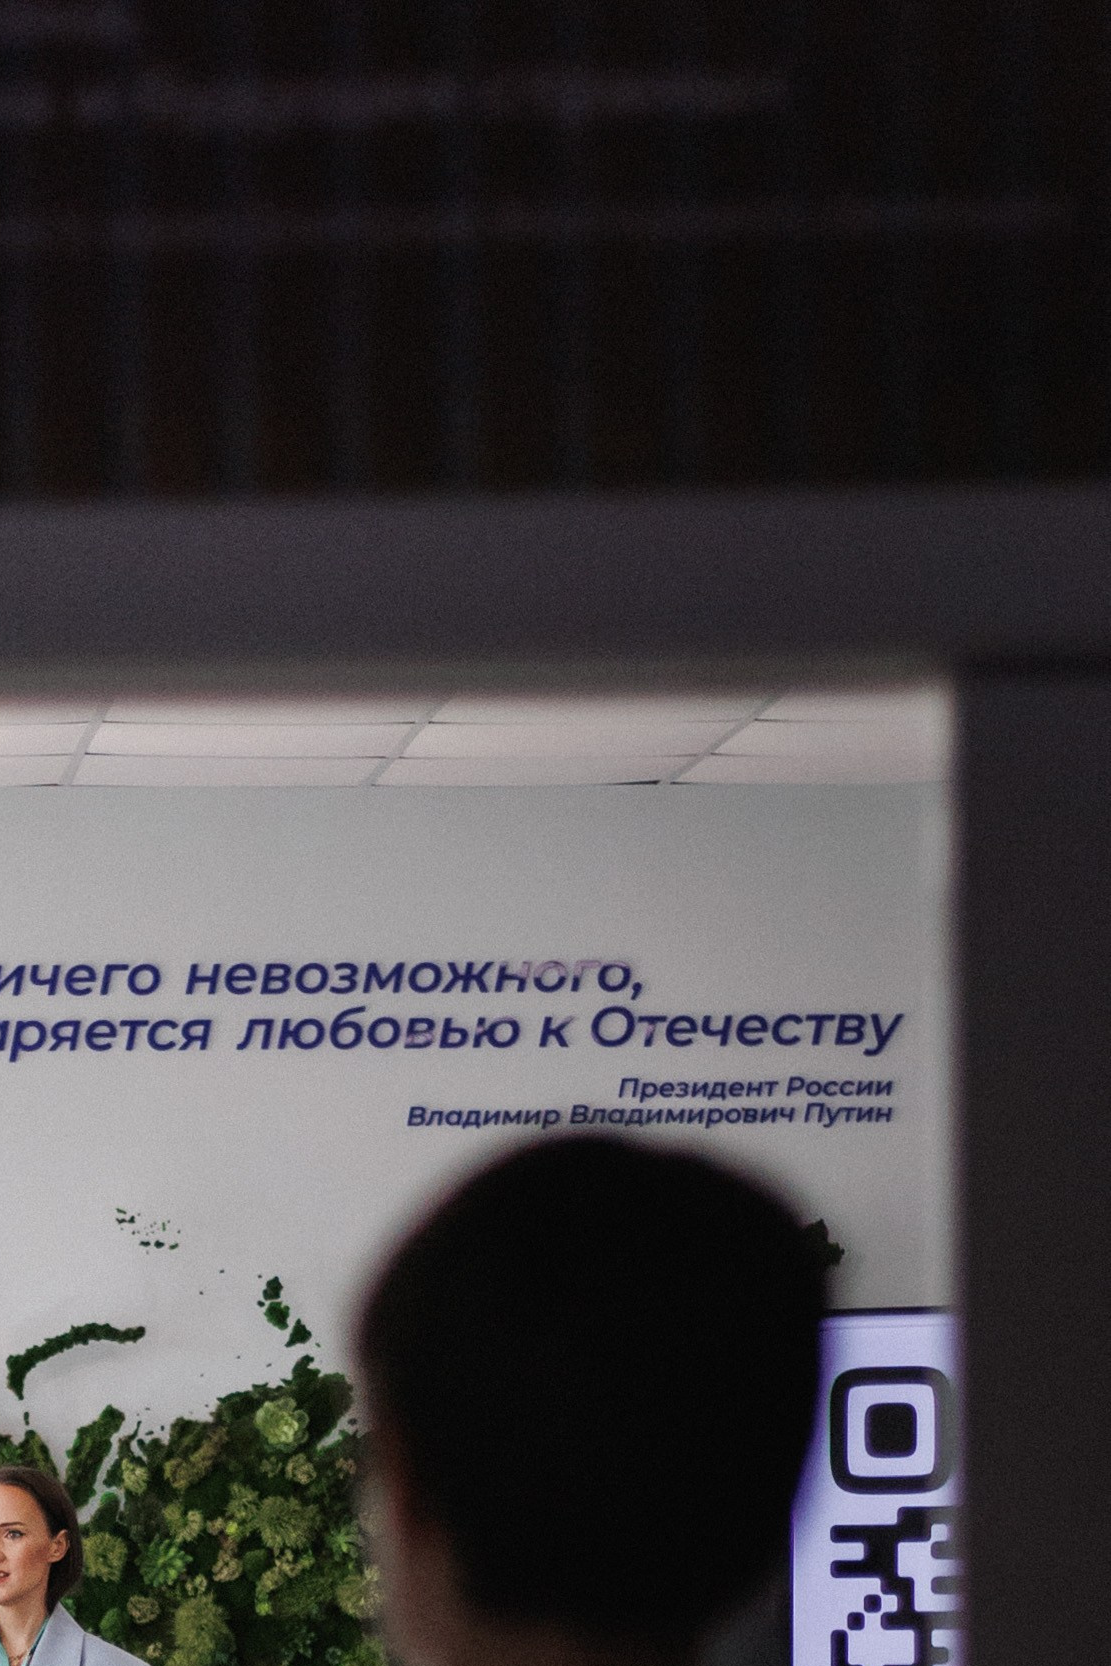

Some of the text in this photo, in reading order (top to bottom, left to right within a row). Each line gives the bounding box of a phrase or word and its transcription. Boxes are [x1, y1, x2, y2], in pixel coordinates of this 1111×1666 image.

[185, 958, 644, 1002] невозможного,
[237, 1006, 520, 1051] любовью
[539, 1015, 574, 1048] к
[591, 1005, 904, 1057] Отечеству
[619, 1076, 894, 1103] Президент России
[408, 1102, 894, 1130] Владимир Владимирович Путин
